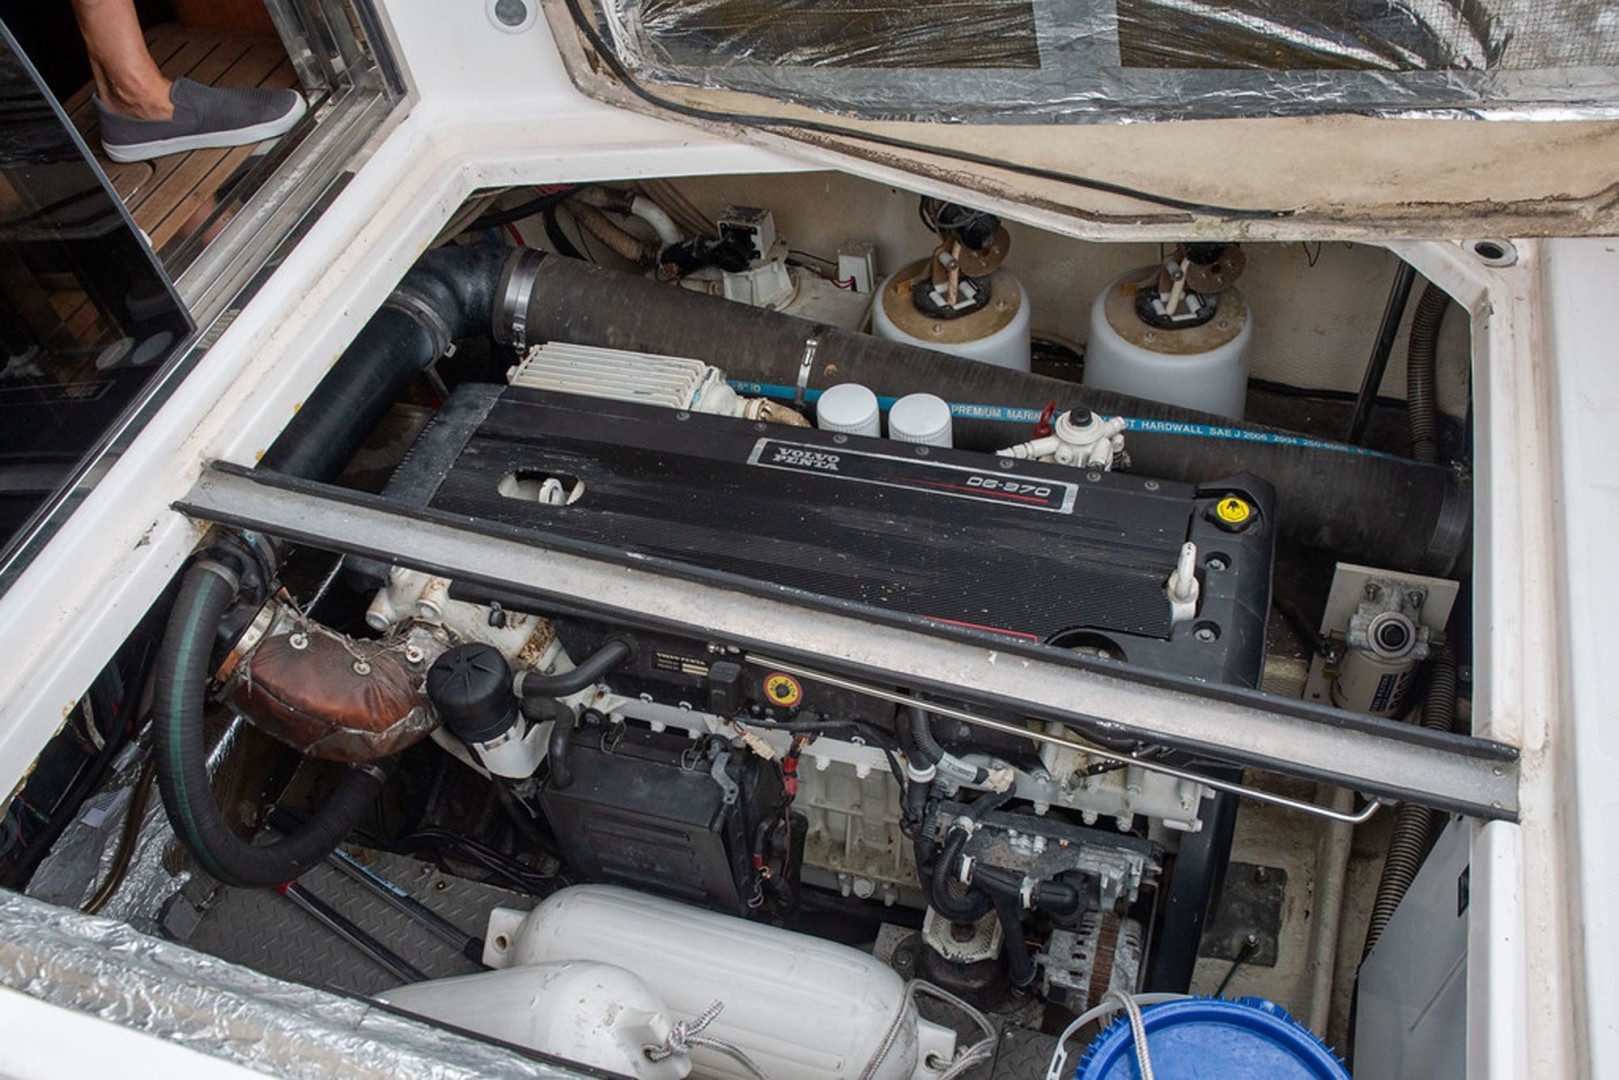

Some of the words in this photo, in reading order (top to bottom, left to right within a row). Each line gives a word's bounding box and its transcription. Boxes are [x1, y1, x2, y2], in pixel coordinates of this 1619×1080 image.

[951, 403, 1001, 418] PREMIUM
[1006, 410, 1041, 421] MARIN
[1141, 421, 1203, 435] HARDWALL
[1209, 427, 1232, 437] SAE
[772, 454, 839, 470] PENTA
[778, 447, 840, 463] VOLVO
